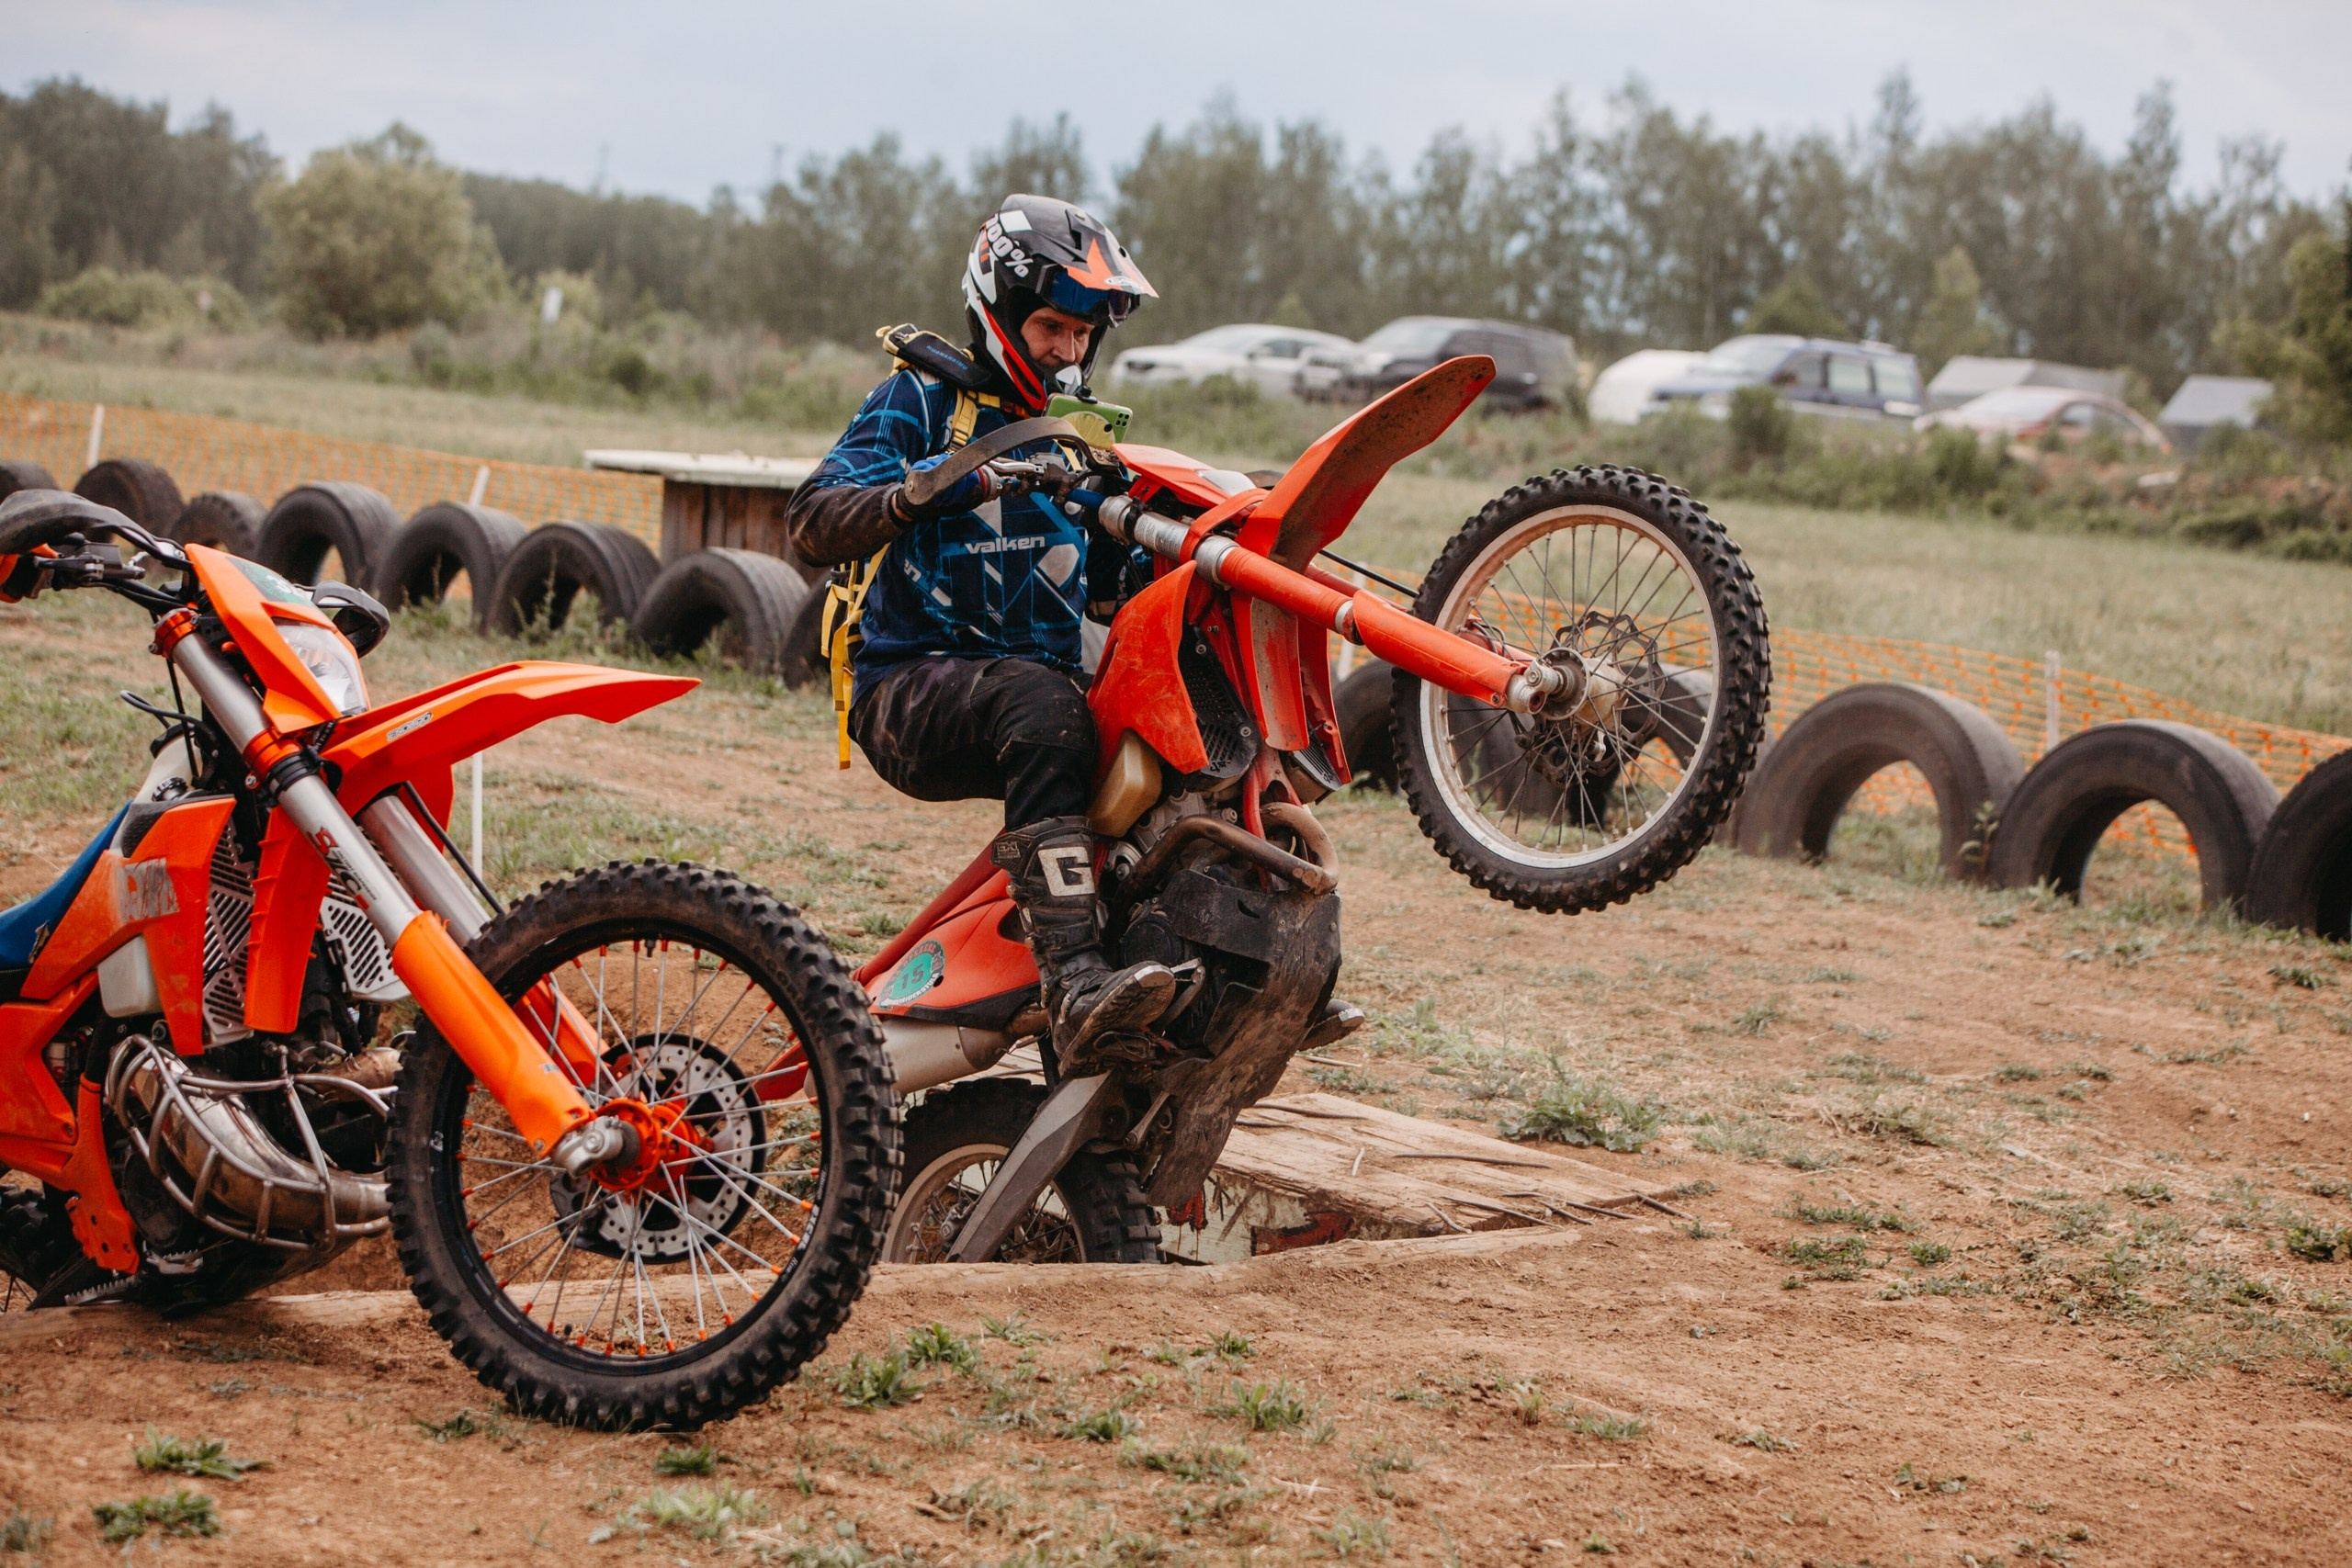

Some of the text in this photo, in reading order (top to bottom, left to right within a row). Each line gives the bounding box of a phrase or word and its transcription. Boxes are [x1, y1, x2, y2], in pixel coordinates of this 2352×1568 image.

[985, 212, 1035, 278] 100%
[965, 536, 1046, 555] valken
[387, 711, 433, 742] ENDURO
[1037, 846, 1095, 897] G
[901, 963, 924, 991] 15
